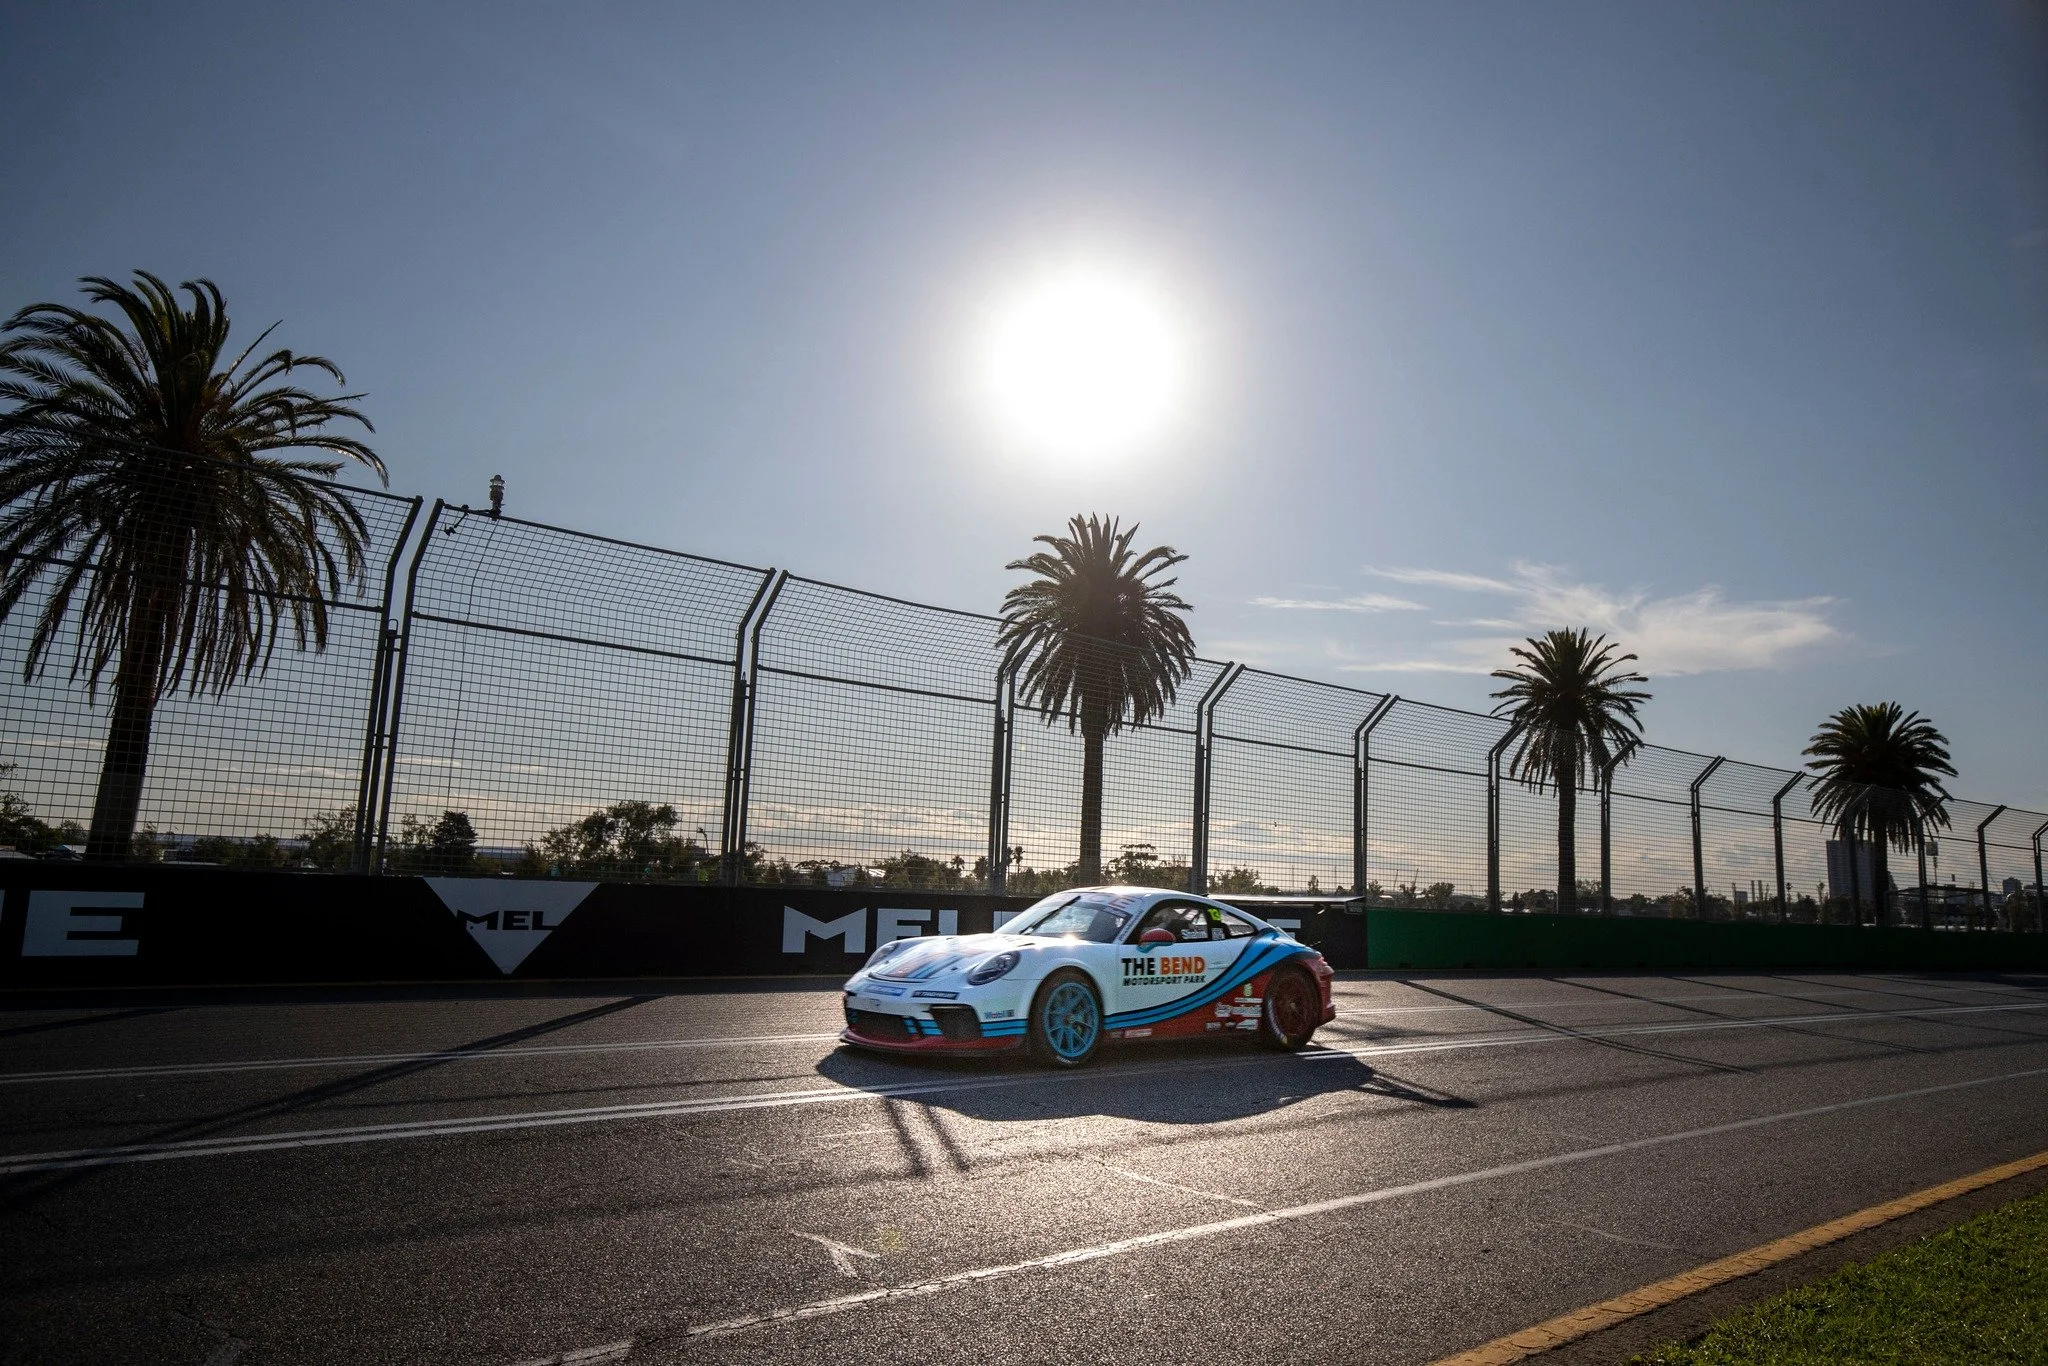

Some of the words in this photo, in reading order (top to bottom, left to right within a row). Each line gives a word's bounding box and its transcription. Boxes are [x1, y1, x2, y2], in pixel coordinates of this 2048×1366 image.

[456, 909, 559, 931] MEL
[1121, 957, 1155, 976] THE
[1160, 956, 1206, 975] BEND
[1122, 976, 1182, 986] MOTORSPORT
[1184, 975, 1206, 984] PARK
